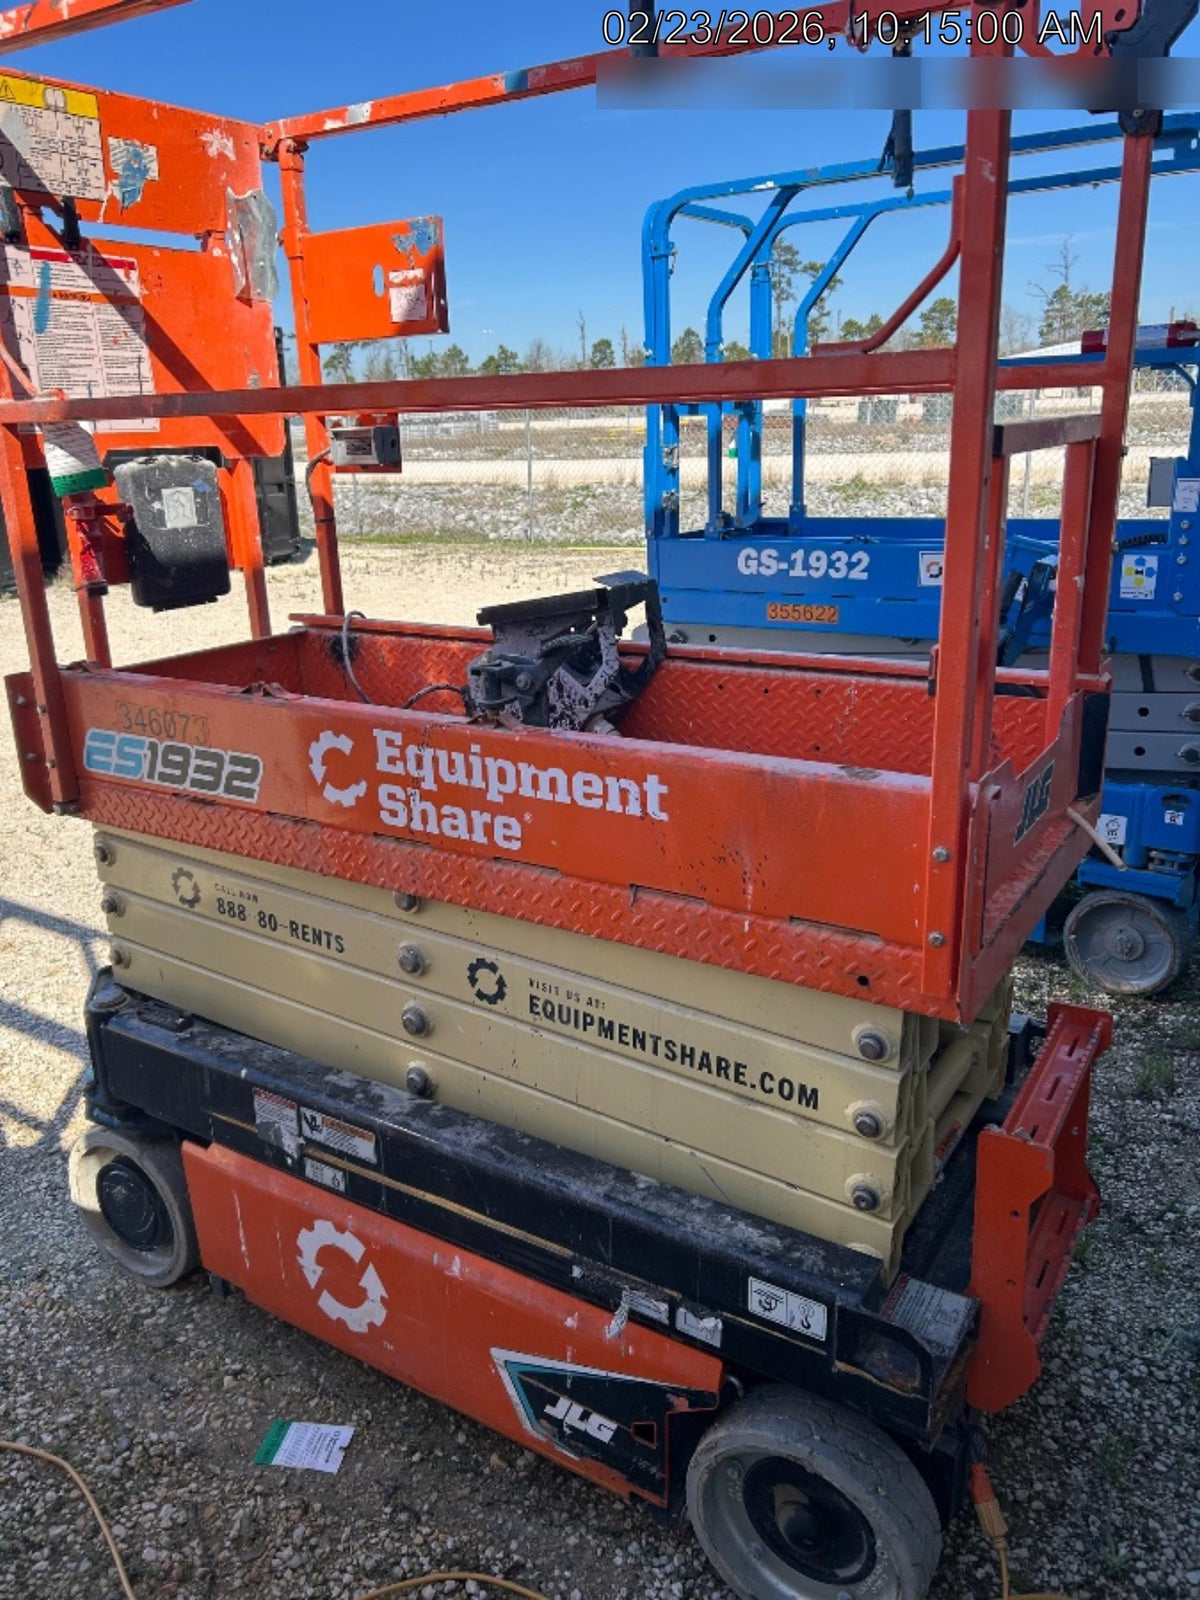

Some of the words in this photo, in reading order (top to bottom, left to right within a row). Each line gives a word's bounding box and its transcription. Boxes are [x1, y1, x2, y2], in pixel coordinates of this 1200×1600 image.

[737, 547, 870, 580] GS-1932
[768, 603, 838, 623] 355622
[117, 703, 211, 748] 346073
[83, 727, 263, 804] ES1932
[373, 728, 669, 822] Equipment
[527, 977, 560, 997] VISIT
[566, 989, 581, 1002] US
[528, 994, 820, 1111] EQUIPMENTSHARE.COM
[544, 1396, 618, 1444] JLG
